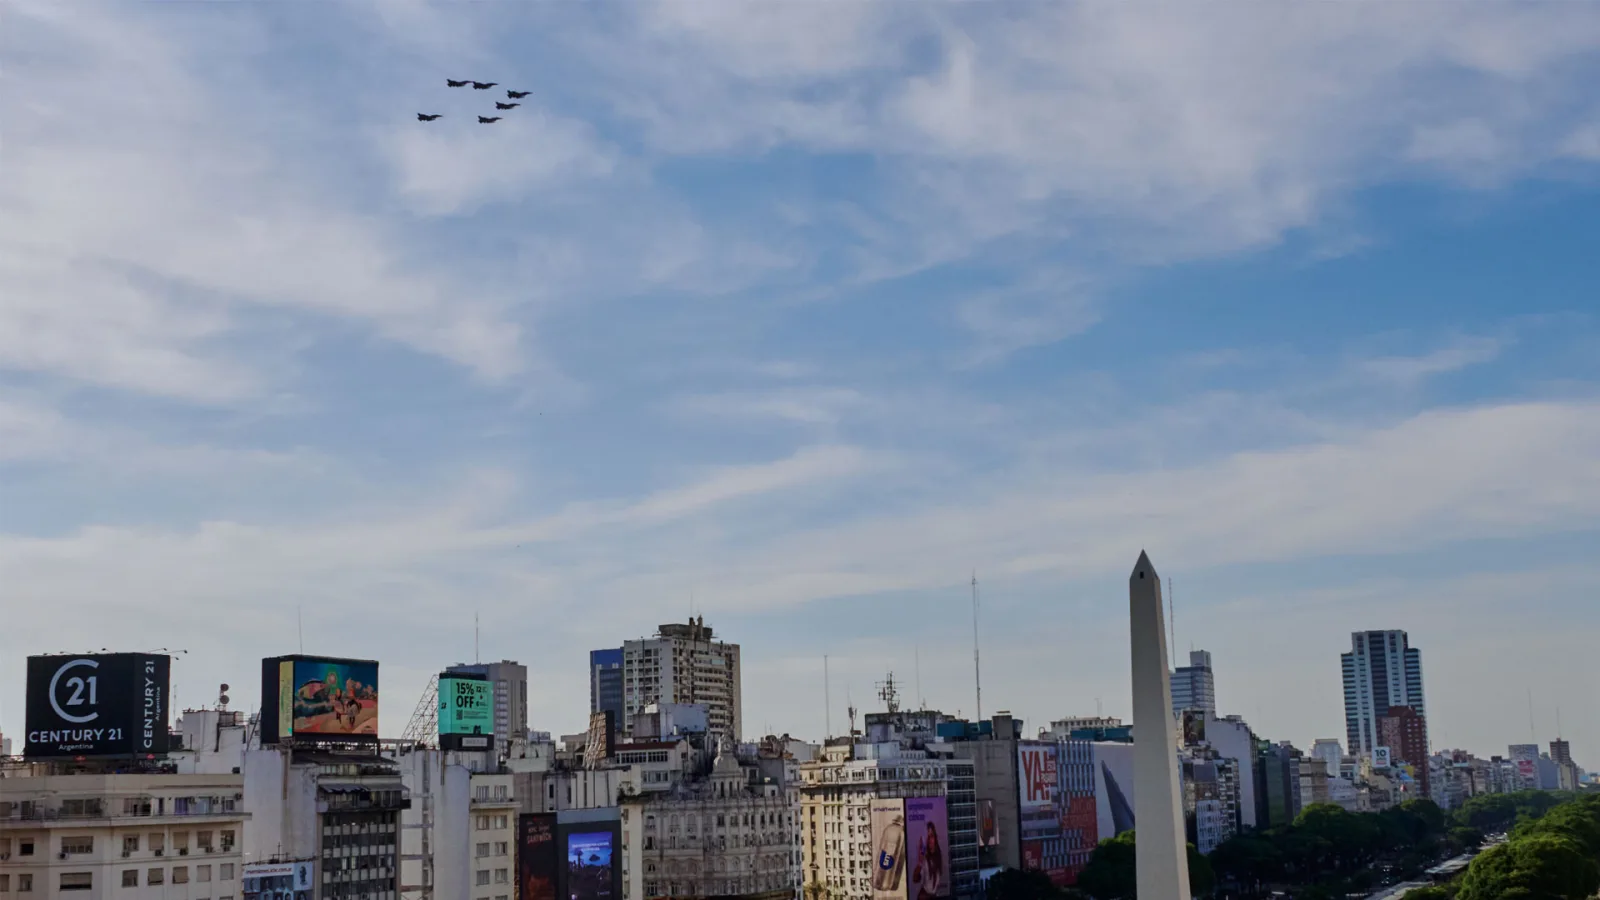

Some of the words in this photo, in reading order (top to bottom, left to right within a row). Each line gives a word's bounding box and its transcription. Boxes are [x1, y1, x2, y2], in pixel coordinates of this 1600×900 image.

[145, 660, 154, 675] 21
[66, 676, 97, 706] 21
[456, 682, 475, 695] 15%
[456, 695, 475, 709] OFF
[143, 677, 154, 748] CENTURY
[29, 728, 104, 743] CENTURY
[108, 728, 122, 740] 21
[58, 743, 94, 752] Argentina
[1375, 749, 1387, 757] 10
